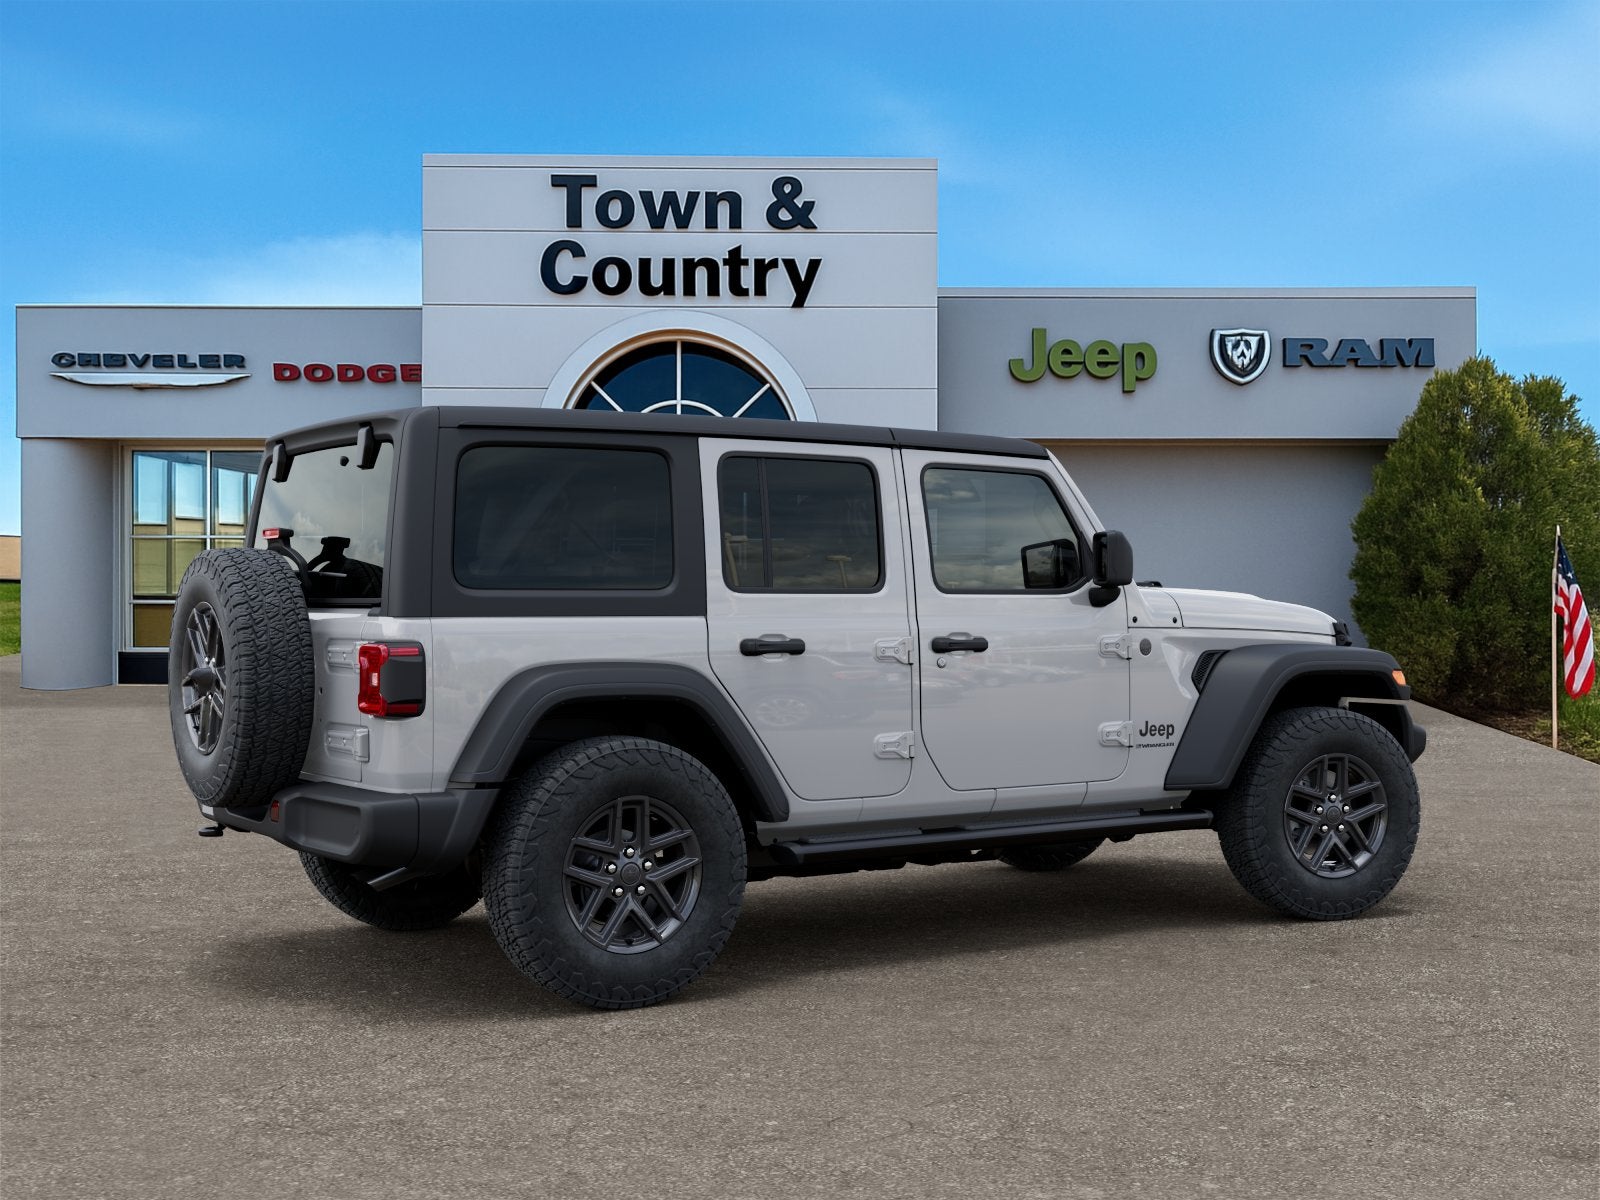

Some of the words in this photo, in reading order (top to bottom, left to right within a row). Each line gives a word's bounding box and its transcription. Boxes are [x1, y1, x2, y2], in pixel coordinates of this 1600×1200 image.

[550, 173, 742, 229] Town
[765, 176, 818, 229] &
[540, 239, 822, 307] Country
[273, 363, 422, 383] DODGE
[1009, 328, 1157, 393] Jeep
[1283, 338, 1435, 367] RAM
[1139, 720, 1175, 739] Jeep
